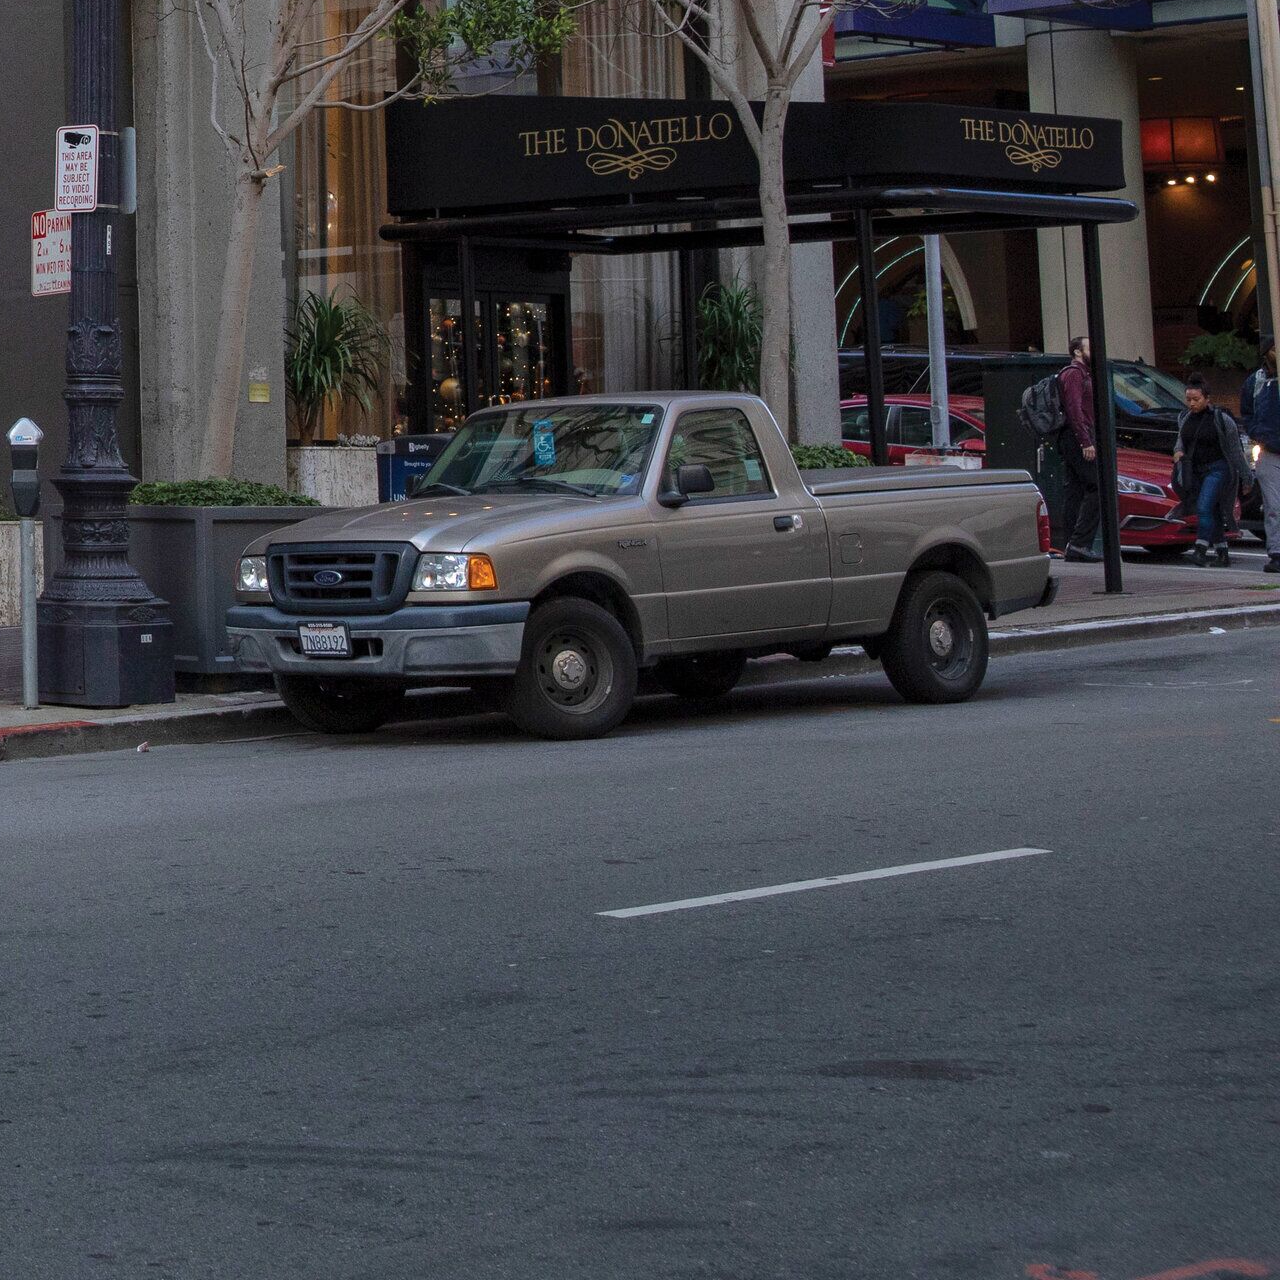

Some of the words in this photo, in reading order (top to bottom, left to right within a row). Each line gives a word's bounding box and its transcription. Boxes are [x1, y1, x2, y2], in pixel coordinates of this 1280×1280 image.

[518, 128, 568, 157] THE
[575, 112, 733, 153] DONATELLO
[959, 118, 996, 142] THE
[998, 119, 1095, 150] DONATELLO
[62, 152, 75, 161] THIS
[76, 151, 93, 161] AREA
[65, 163, 78, 172] MAY
[79, 162, 88, 171] BE
[63, 173, 90, 183] SUBJECT
[62, 185, 70, 194] TO
[71, 184, 90, 194] VIDEO
[58, 195, 93, 205] RECORDING
[33, 214, 46, 236] NO
[47, 215, 71, 234] PARKIN
[302, 634, 345, 650] 7N88192
